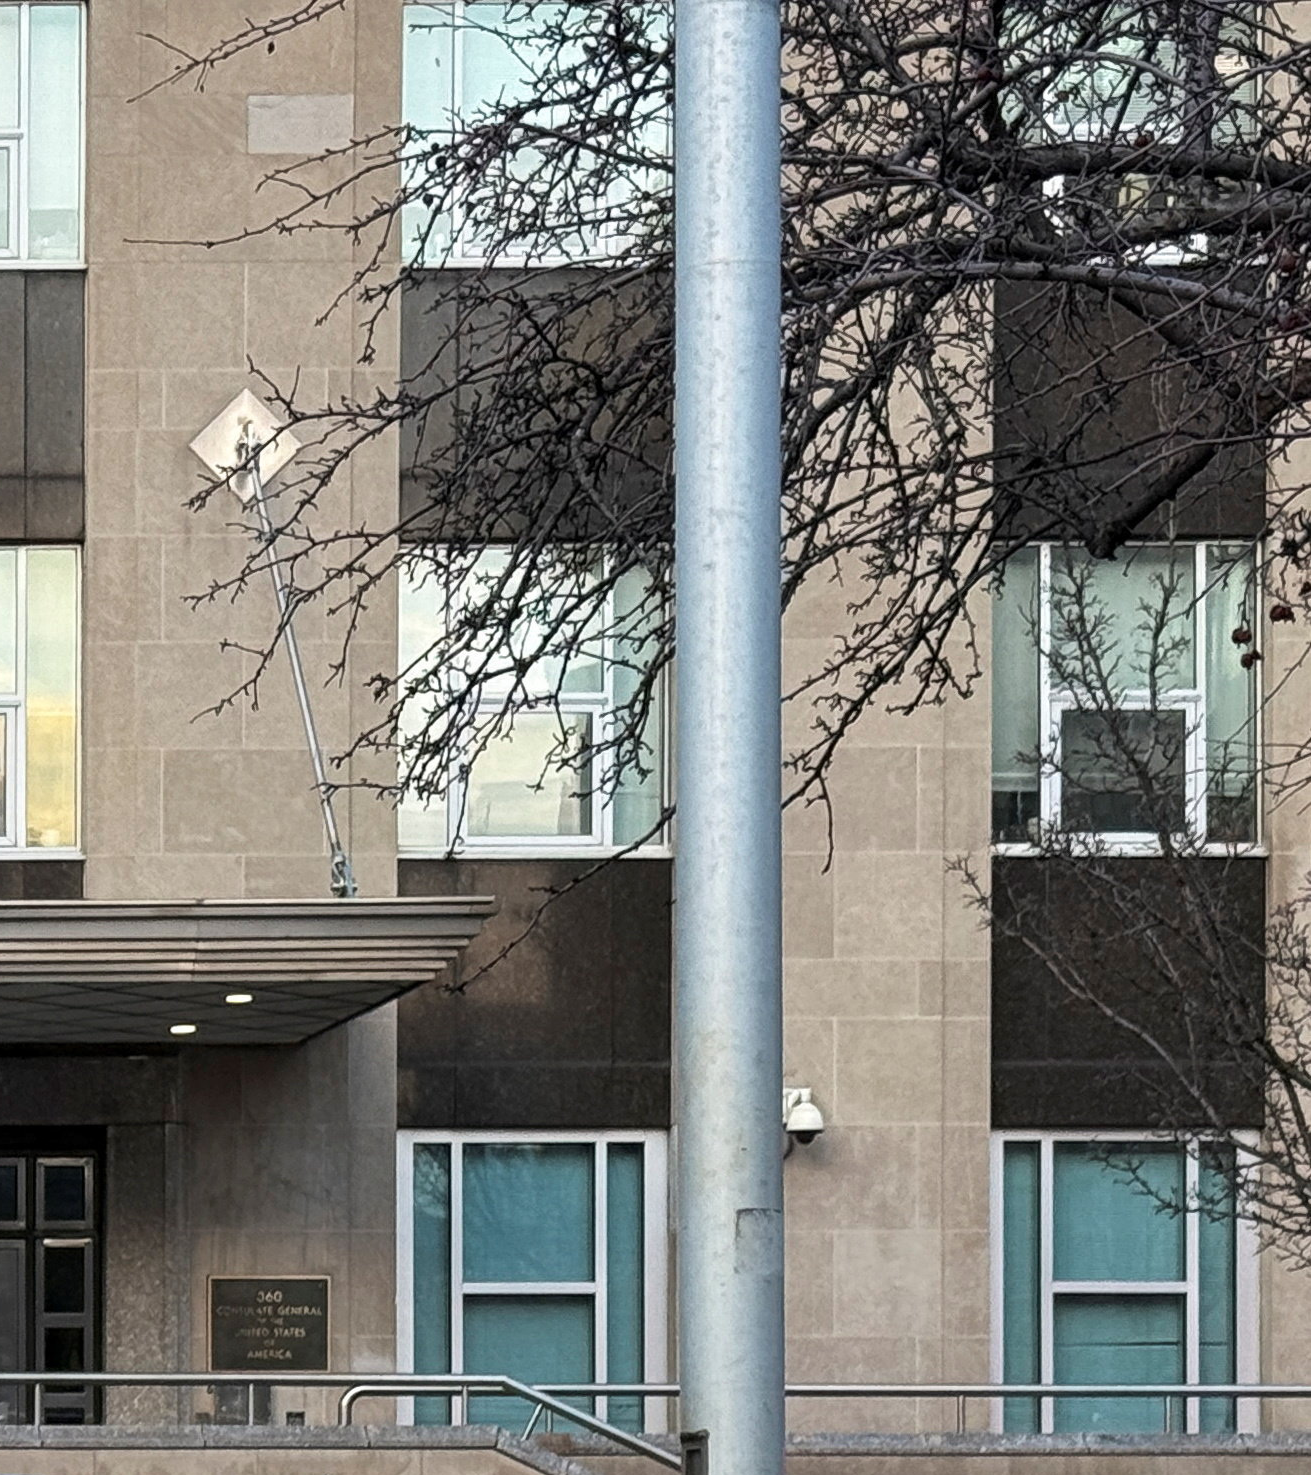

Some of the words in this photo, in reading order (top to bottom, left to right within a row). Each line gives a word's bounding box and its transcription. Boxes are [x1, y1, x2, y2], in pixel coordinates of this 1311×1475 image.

[256, 1289, 283, 1303] 360
[277, 1305, 322, 1317] GENERAL
[273, 1327, 306, 1338] STATES
[247, 1349, 293, 1360] AMERICA
